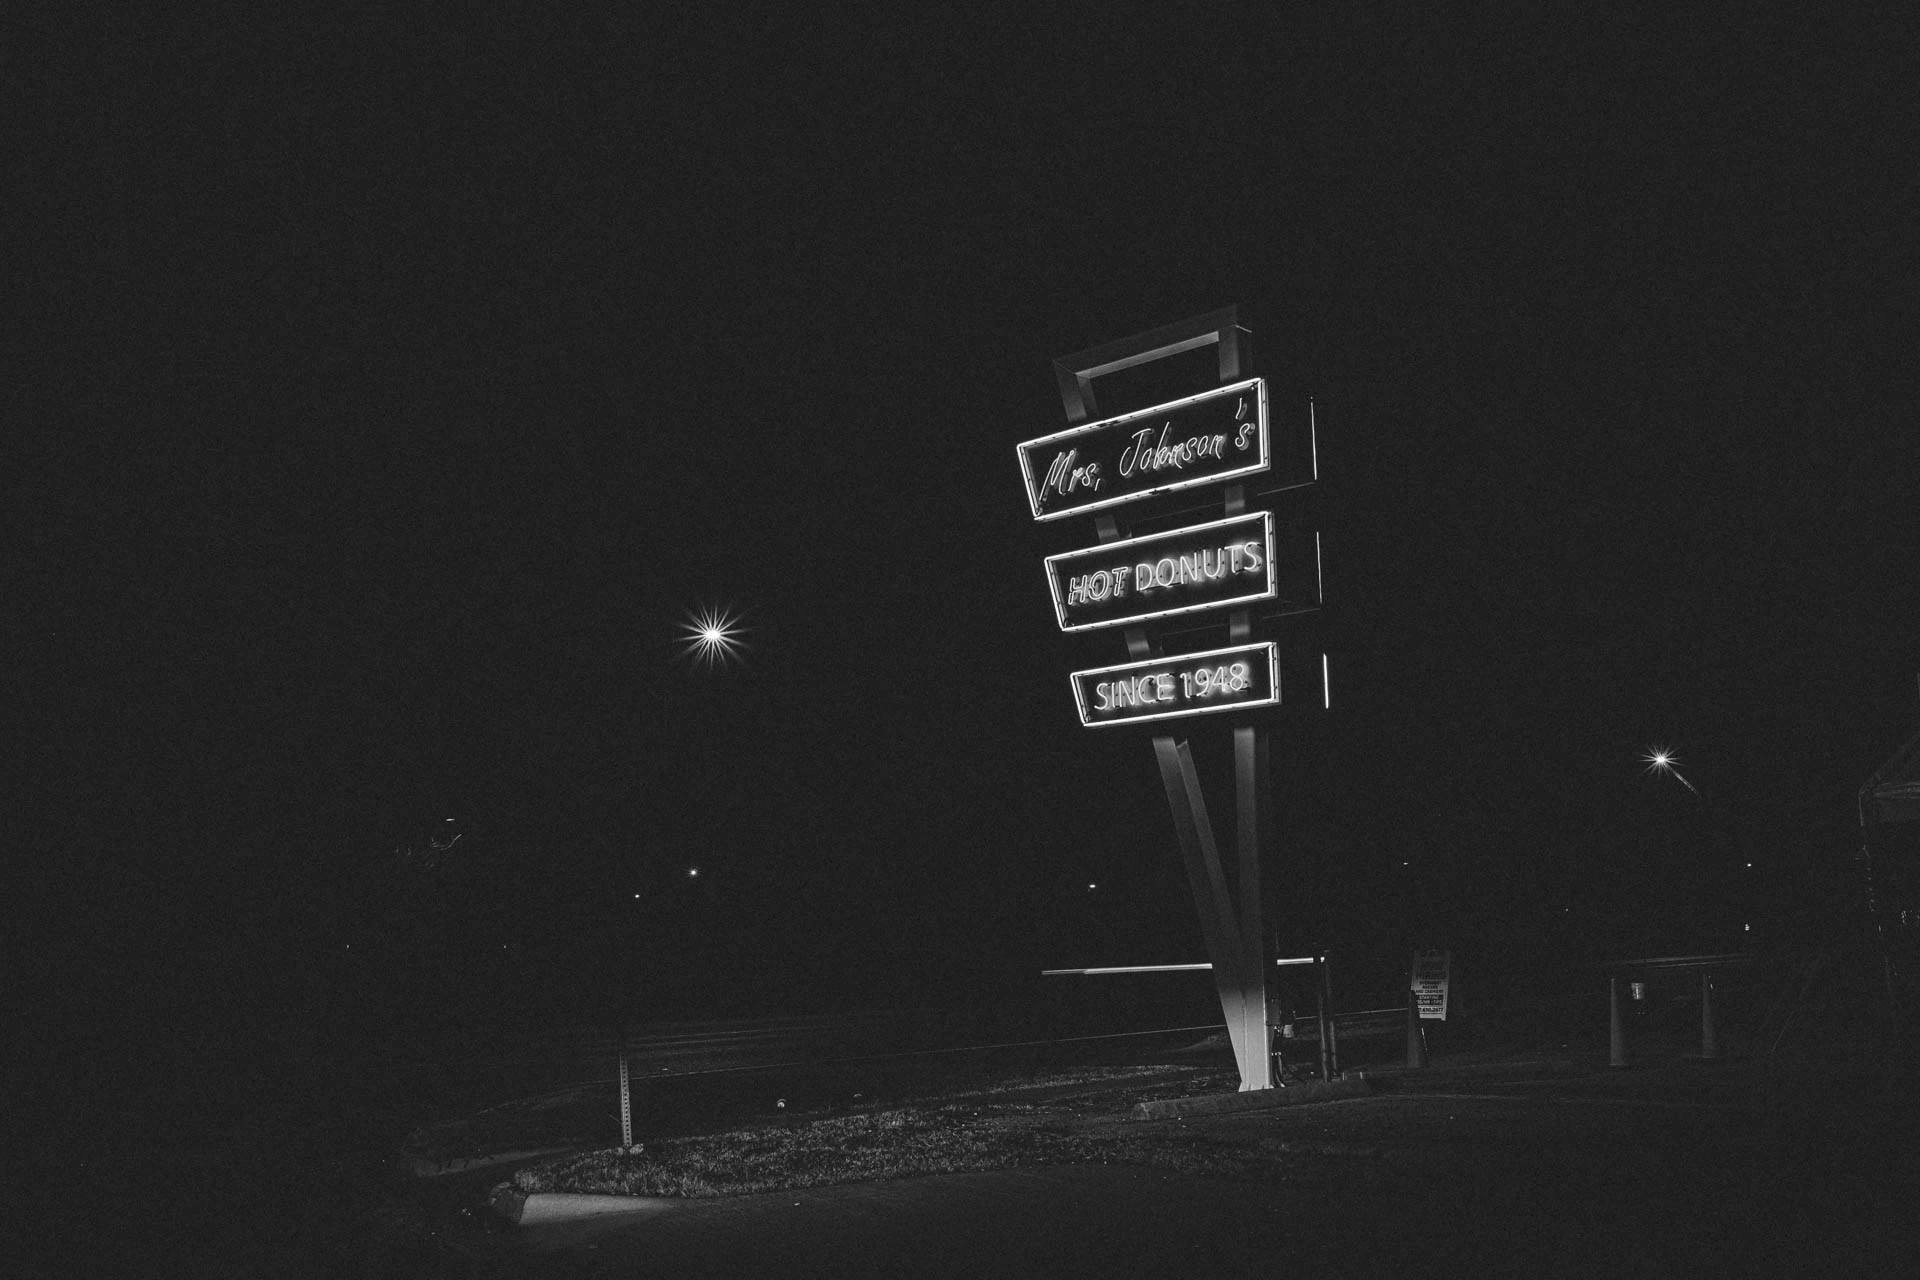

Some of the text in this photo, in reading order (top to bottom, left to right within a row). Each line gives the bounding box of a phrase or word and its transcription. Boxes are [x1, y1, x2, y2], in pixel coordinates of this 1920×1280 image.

[1067, 541, 1264, 606] HOT DONUTS
[1093, 662, 1249, 711] SINCE 1948
